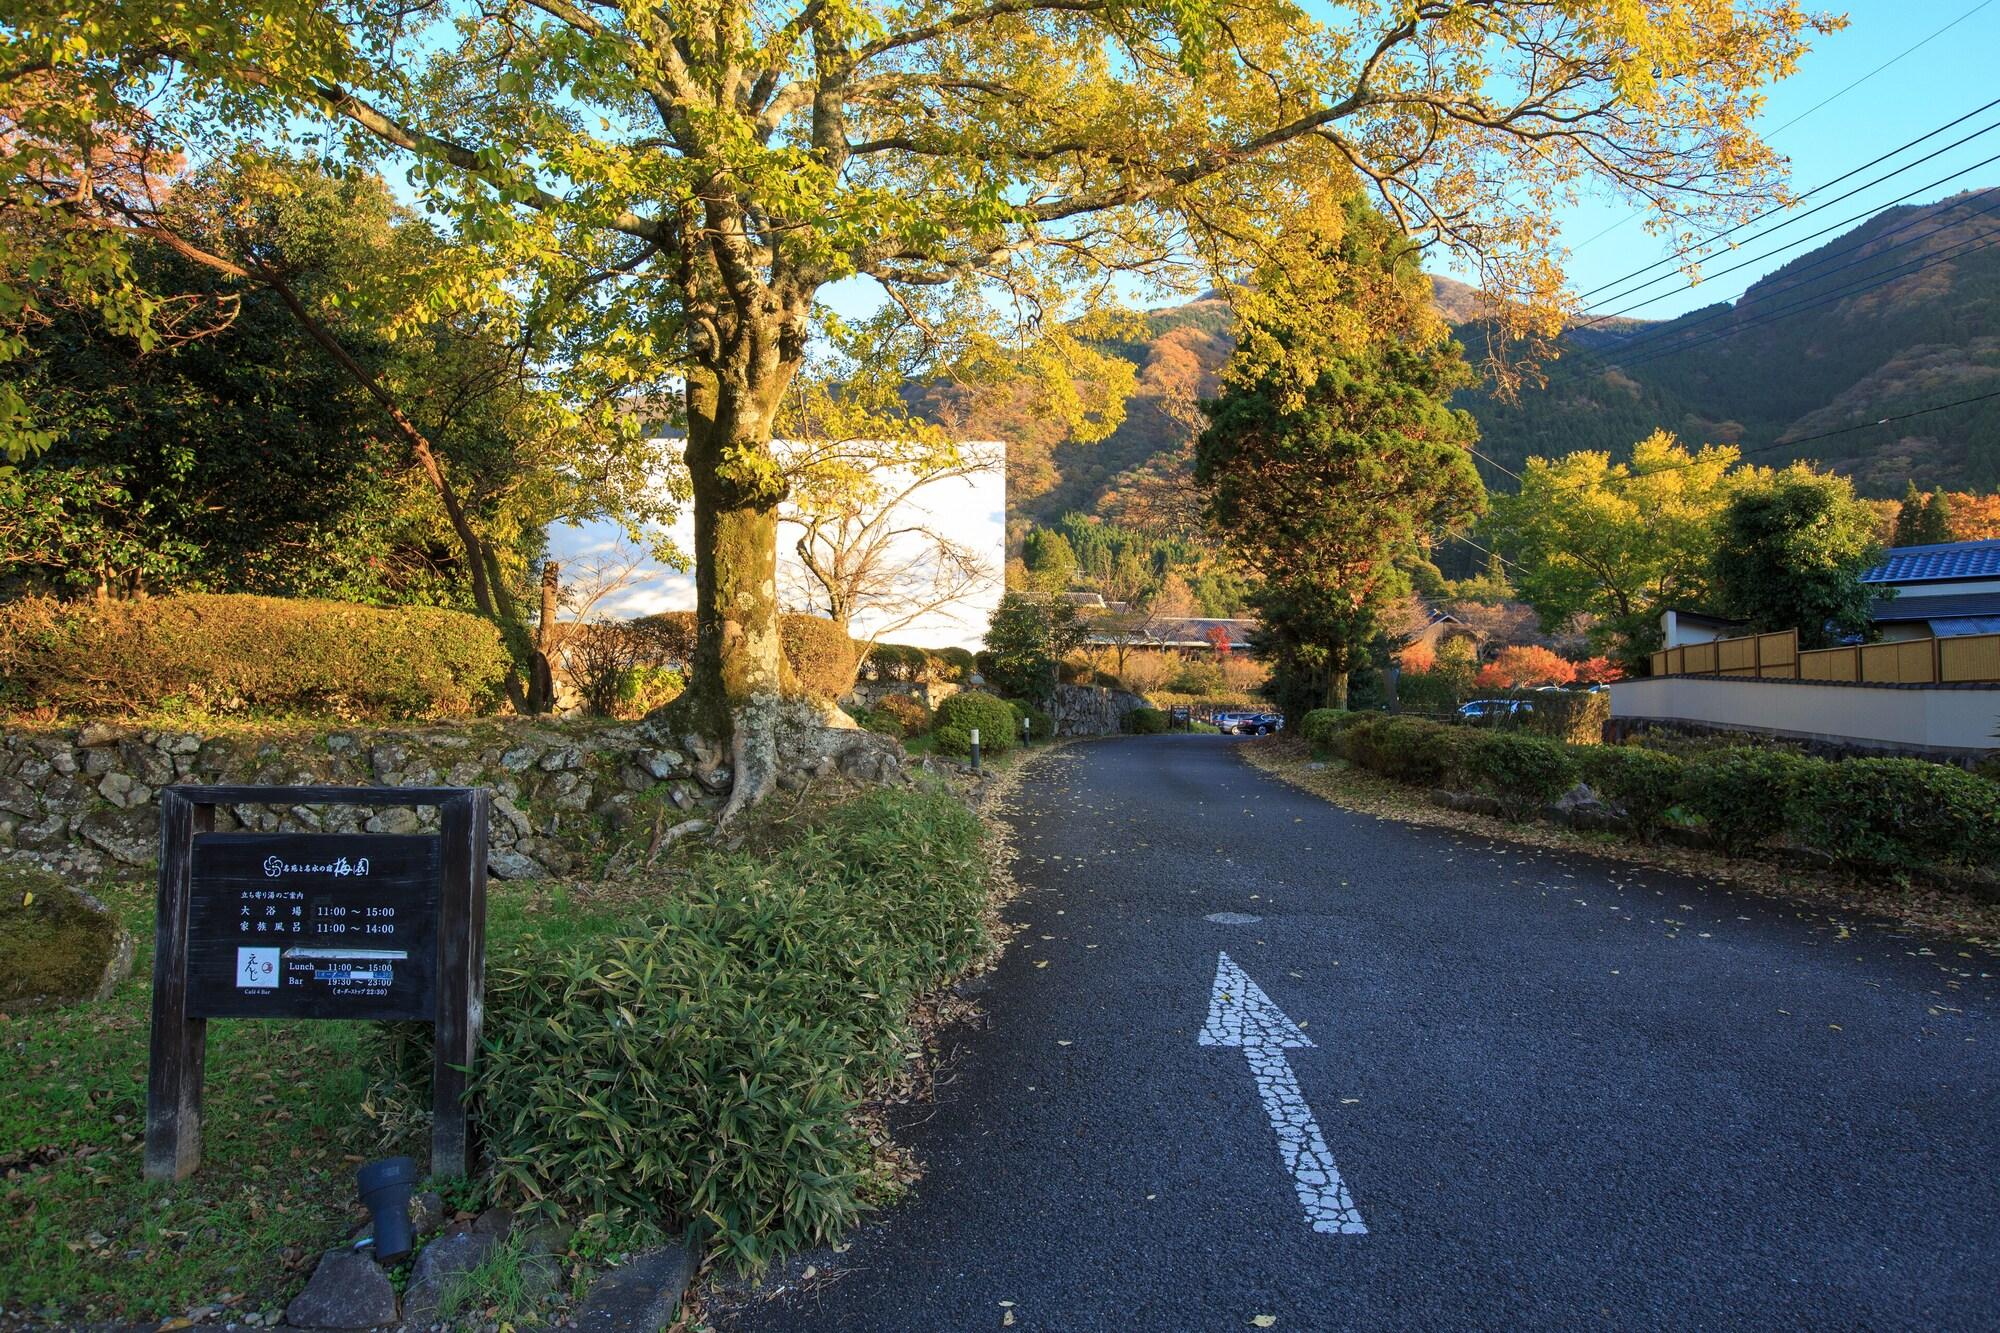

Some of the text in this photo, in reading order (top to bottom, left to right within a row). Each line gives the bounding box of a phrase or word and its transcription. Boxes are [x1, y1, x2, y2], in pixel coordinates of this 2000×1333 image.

[333, 856, 370, 878] 梅園
[240, 891, 304, 900] 立ち寄り湯のご案内
[240, 905, 302, 917] 大浴場
[317, 907, 346, 917] 11:00
[366, 907, 395, 917] 15:00
[240, 922, 302, 933] 家族風呂
[317, 923, 345, 933] 11:00
[365, 923, 394, 934] 14:00
[244, 953, 258, 982] えんじ
[289, 962, 315, 971] Lunch
[328, 963, 352, 972] 11:00
[368, 963, 393, 972] 15:00
[288, 977, 303, 985] Bar
[327, 978, 352, 986] 19:30
[367, 978, 392, 987] 23:00
